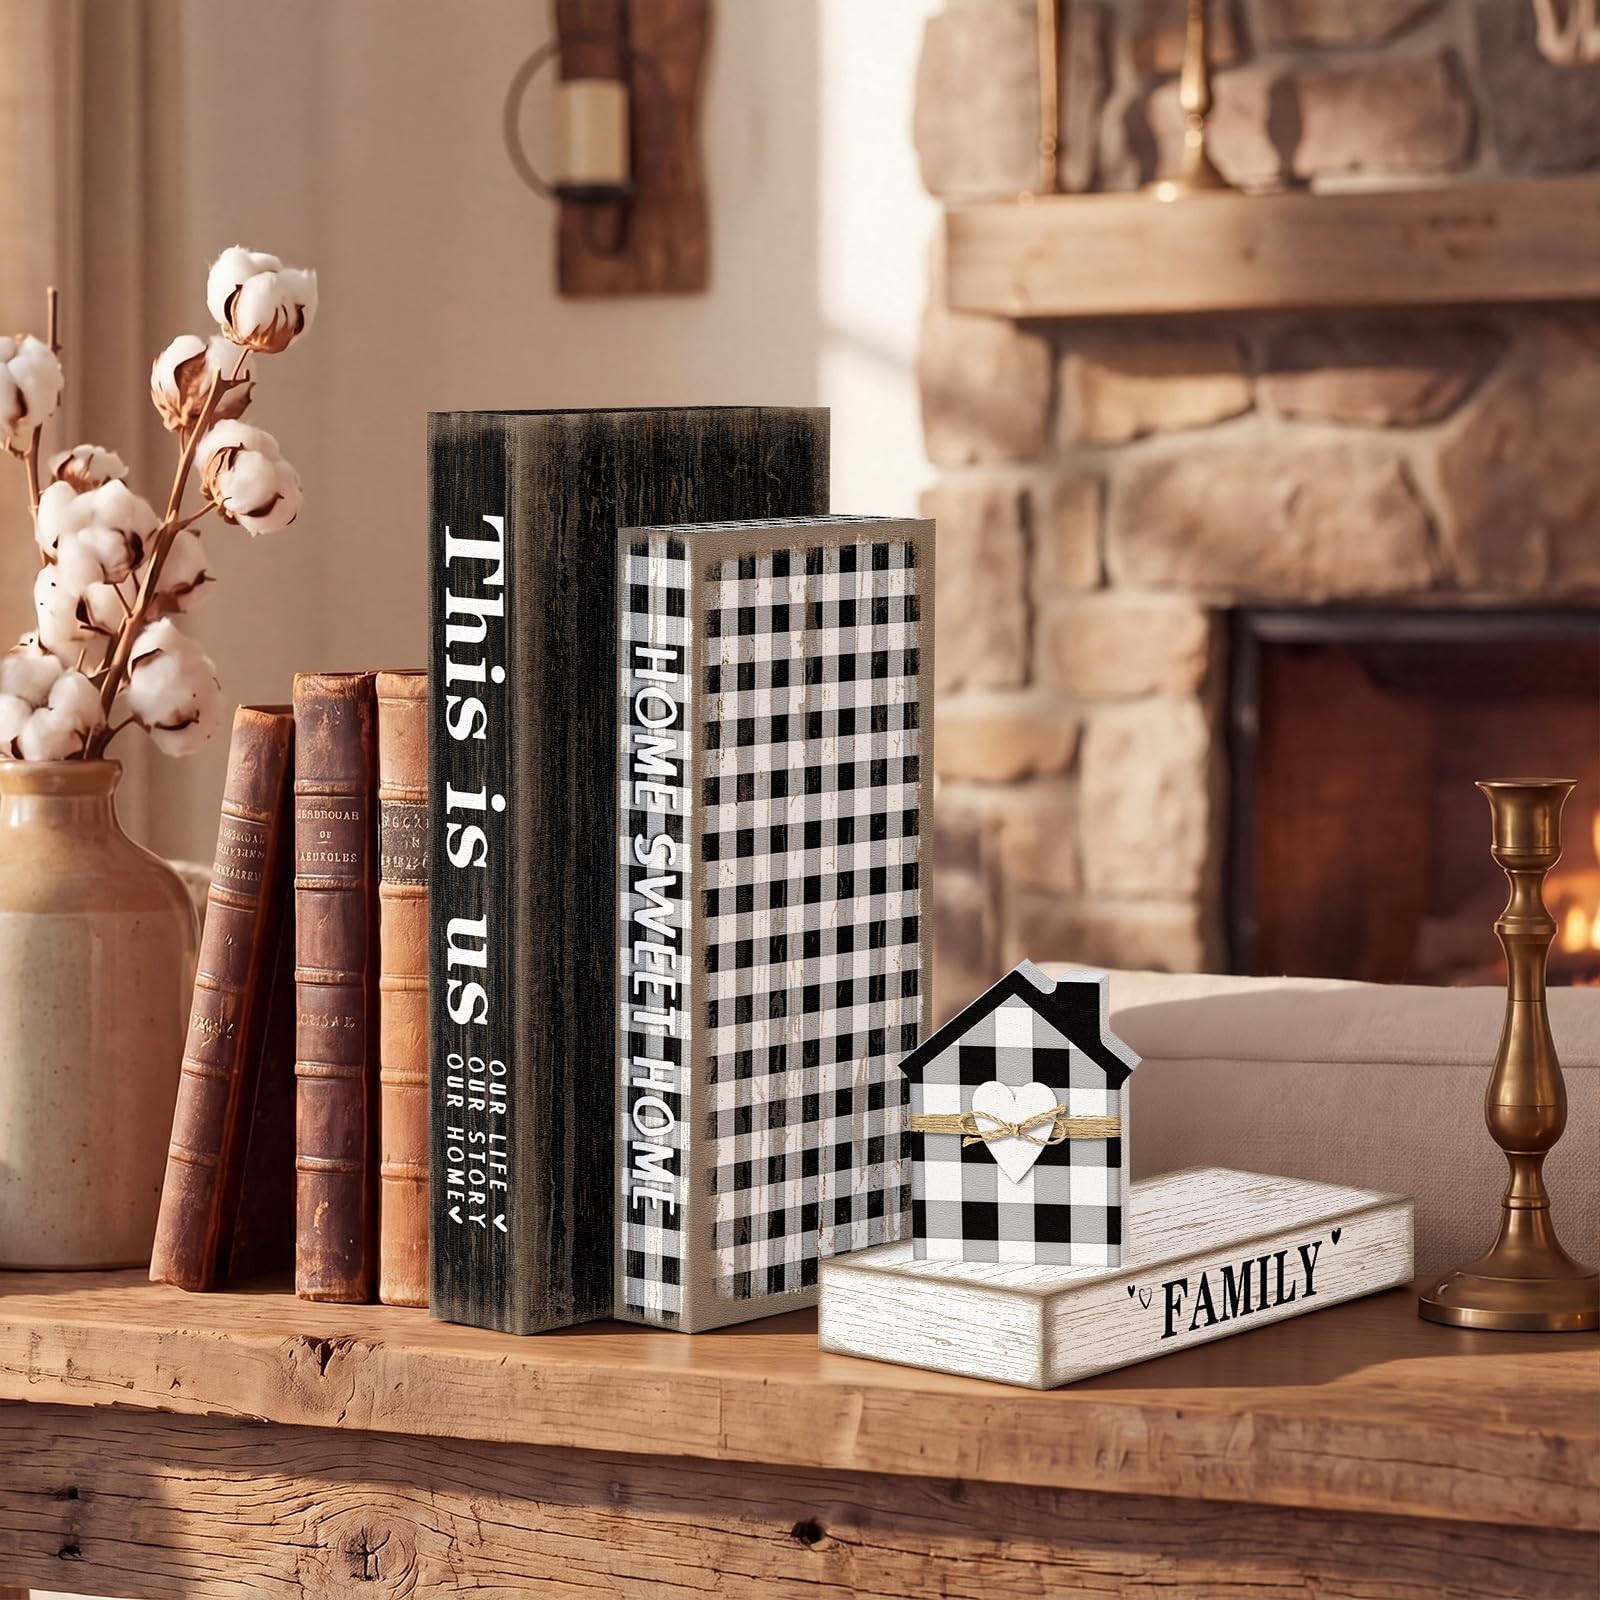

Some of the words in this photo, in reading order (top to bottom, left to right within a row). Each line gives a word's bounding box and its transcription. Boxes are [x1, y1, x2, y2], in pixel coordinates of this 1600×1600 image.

[445, 514, 506, 741] This
[634, 646, 679, 810] HOME
[446, 781, 507, 869] is
[446, 913, 489, 1026] us
[633, 832, 677, 1036] SWEET
[446, 1053, 464, 1108] OUR
[468, 1056, 486, 1112] OUR
[489, 1059, 507, 1115] OUR
[447, 1126, 465, 1202] HOME
[468, 1131, 486, 1229] STORY
[489, 1133, 507, 1193] LIFE
[632, 1055, 675, 1216] HOME
[1161, 1240, 1323, 1339] FAMILY
